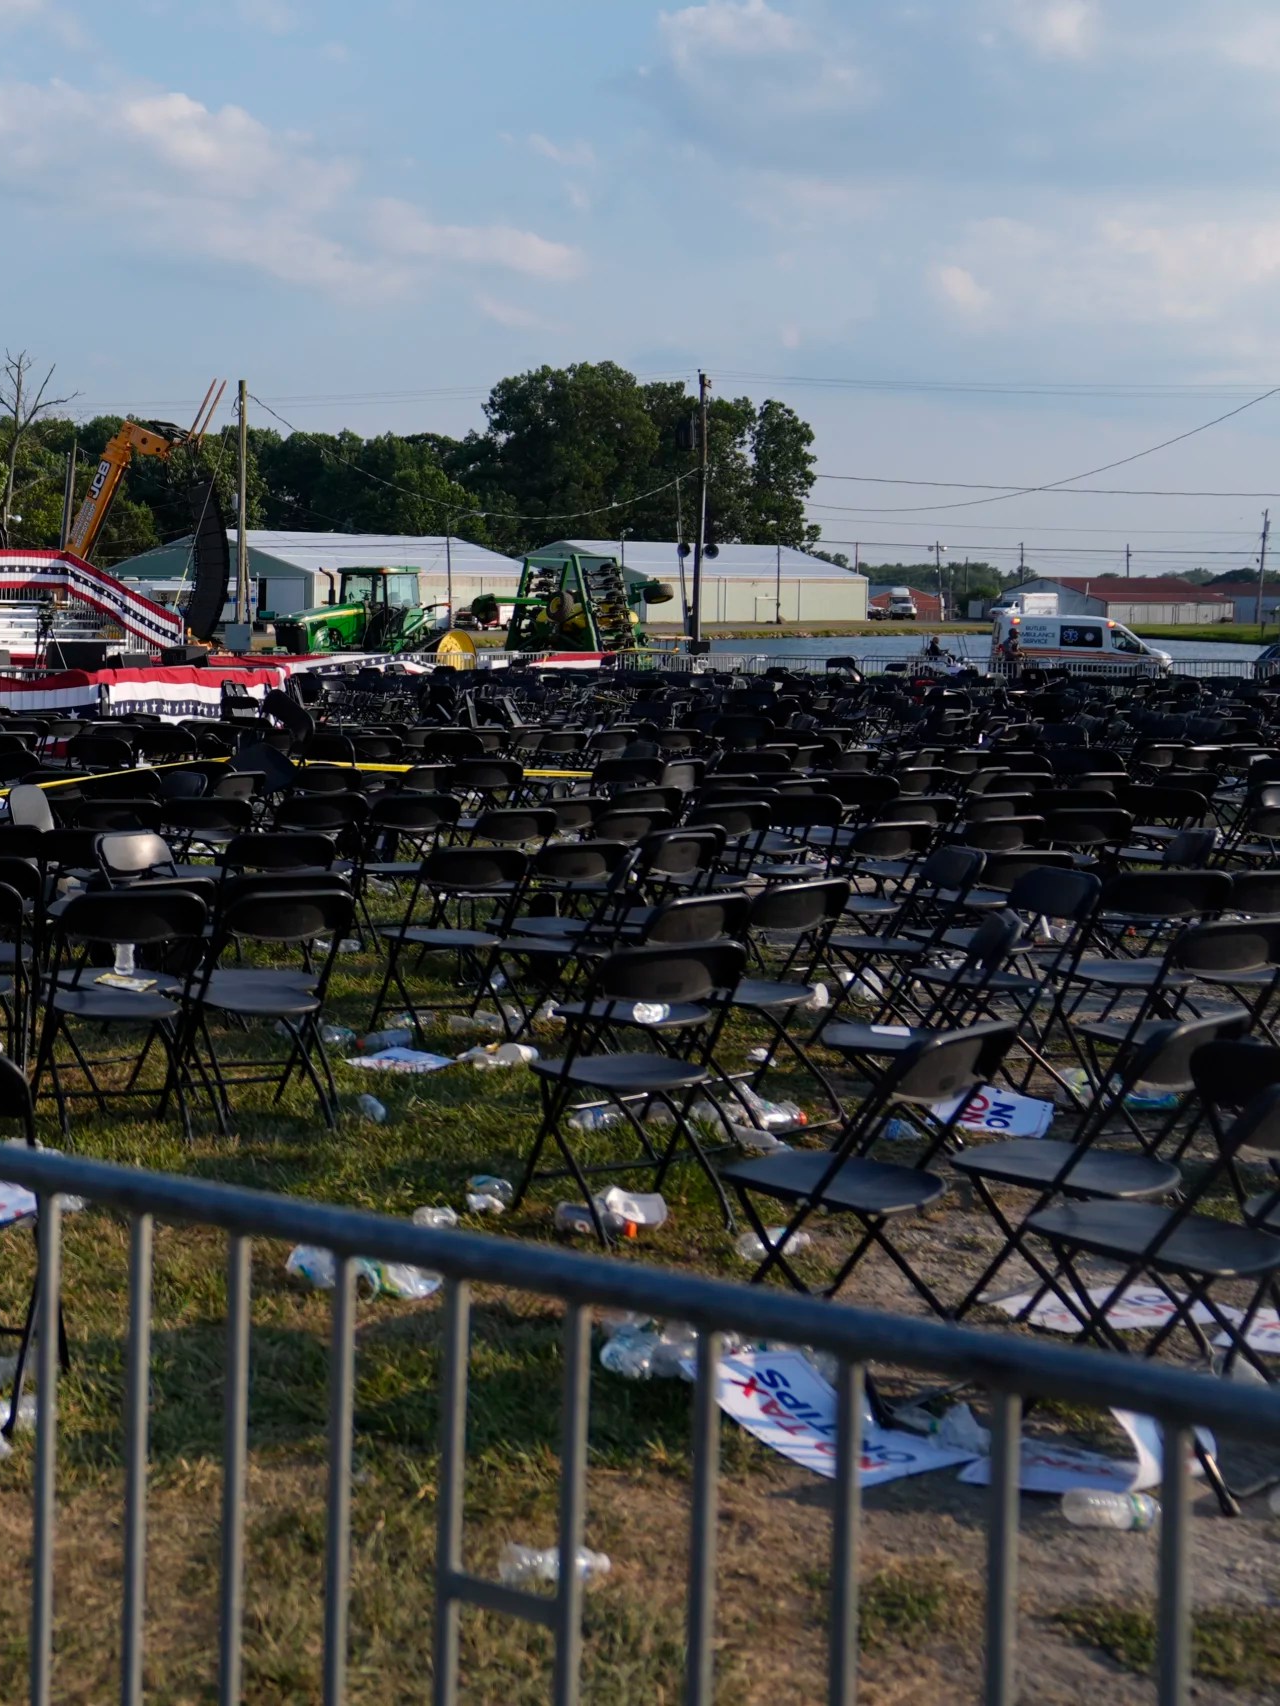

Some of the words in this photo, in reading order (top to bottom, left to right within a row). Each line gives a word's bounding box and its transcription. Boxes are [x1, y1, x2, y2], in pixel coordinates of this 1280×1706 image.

[91, 461, 111, 499] JCB
[961, 1093, 989, 1125] NO
[986, 1101, 1016, 1128] ON
[730, 1376, 808, 1436] TAX
[756, 1368, 839, 1436] TIPS
